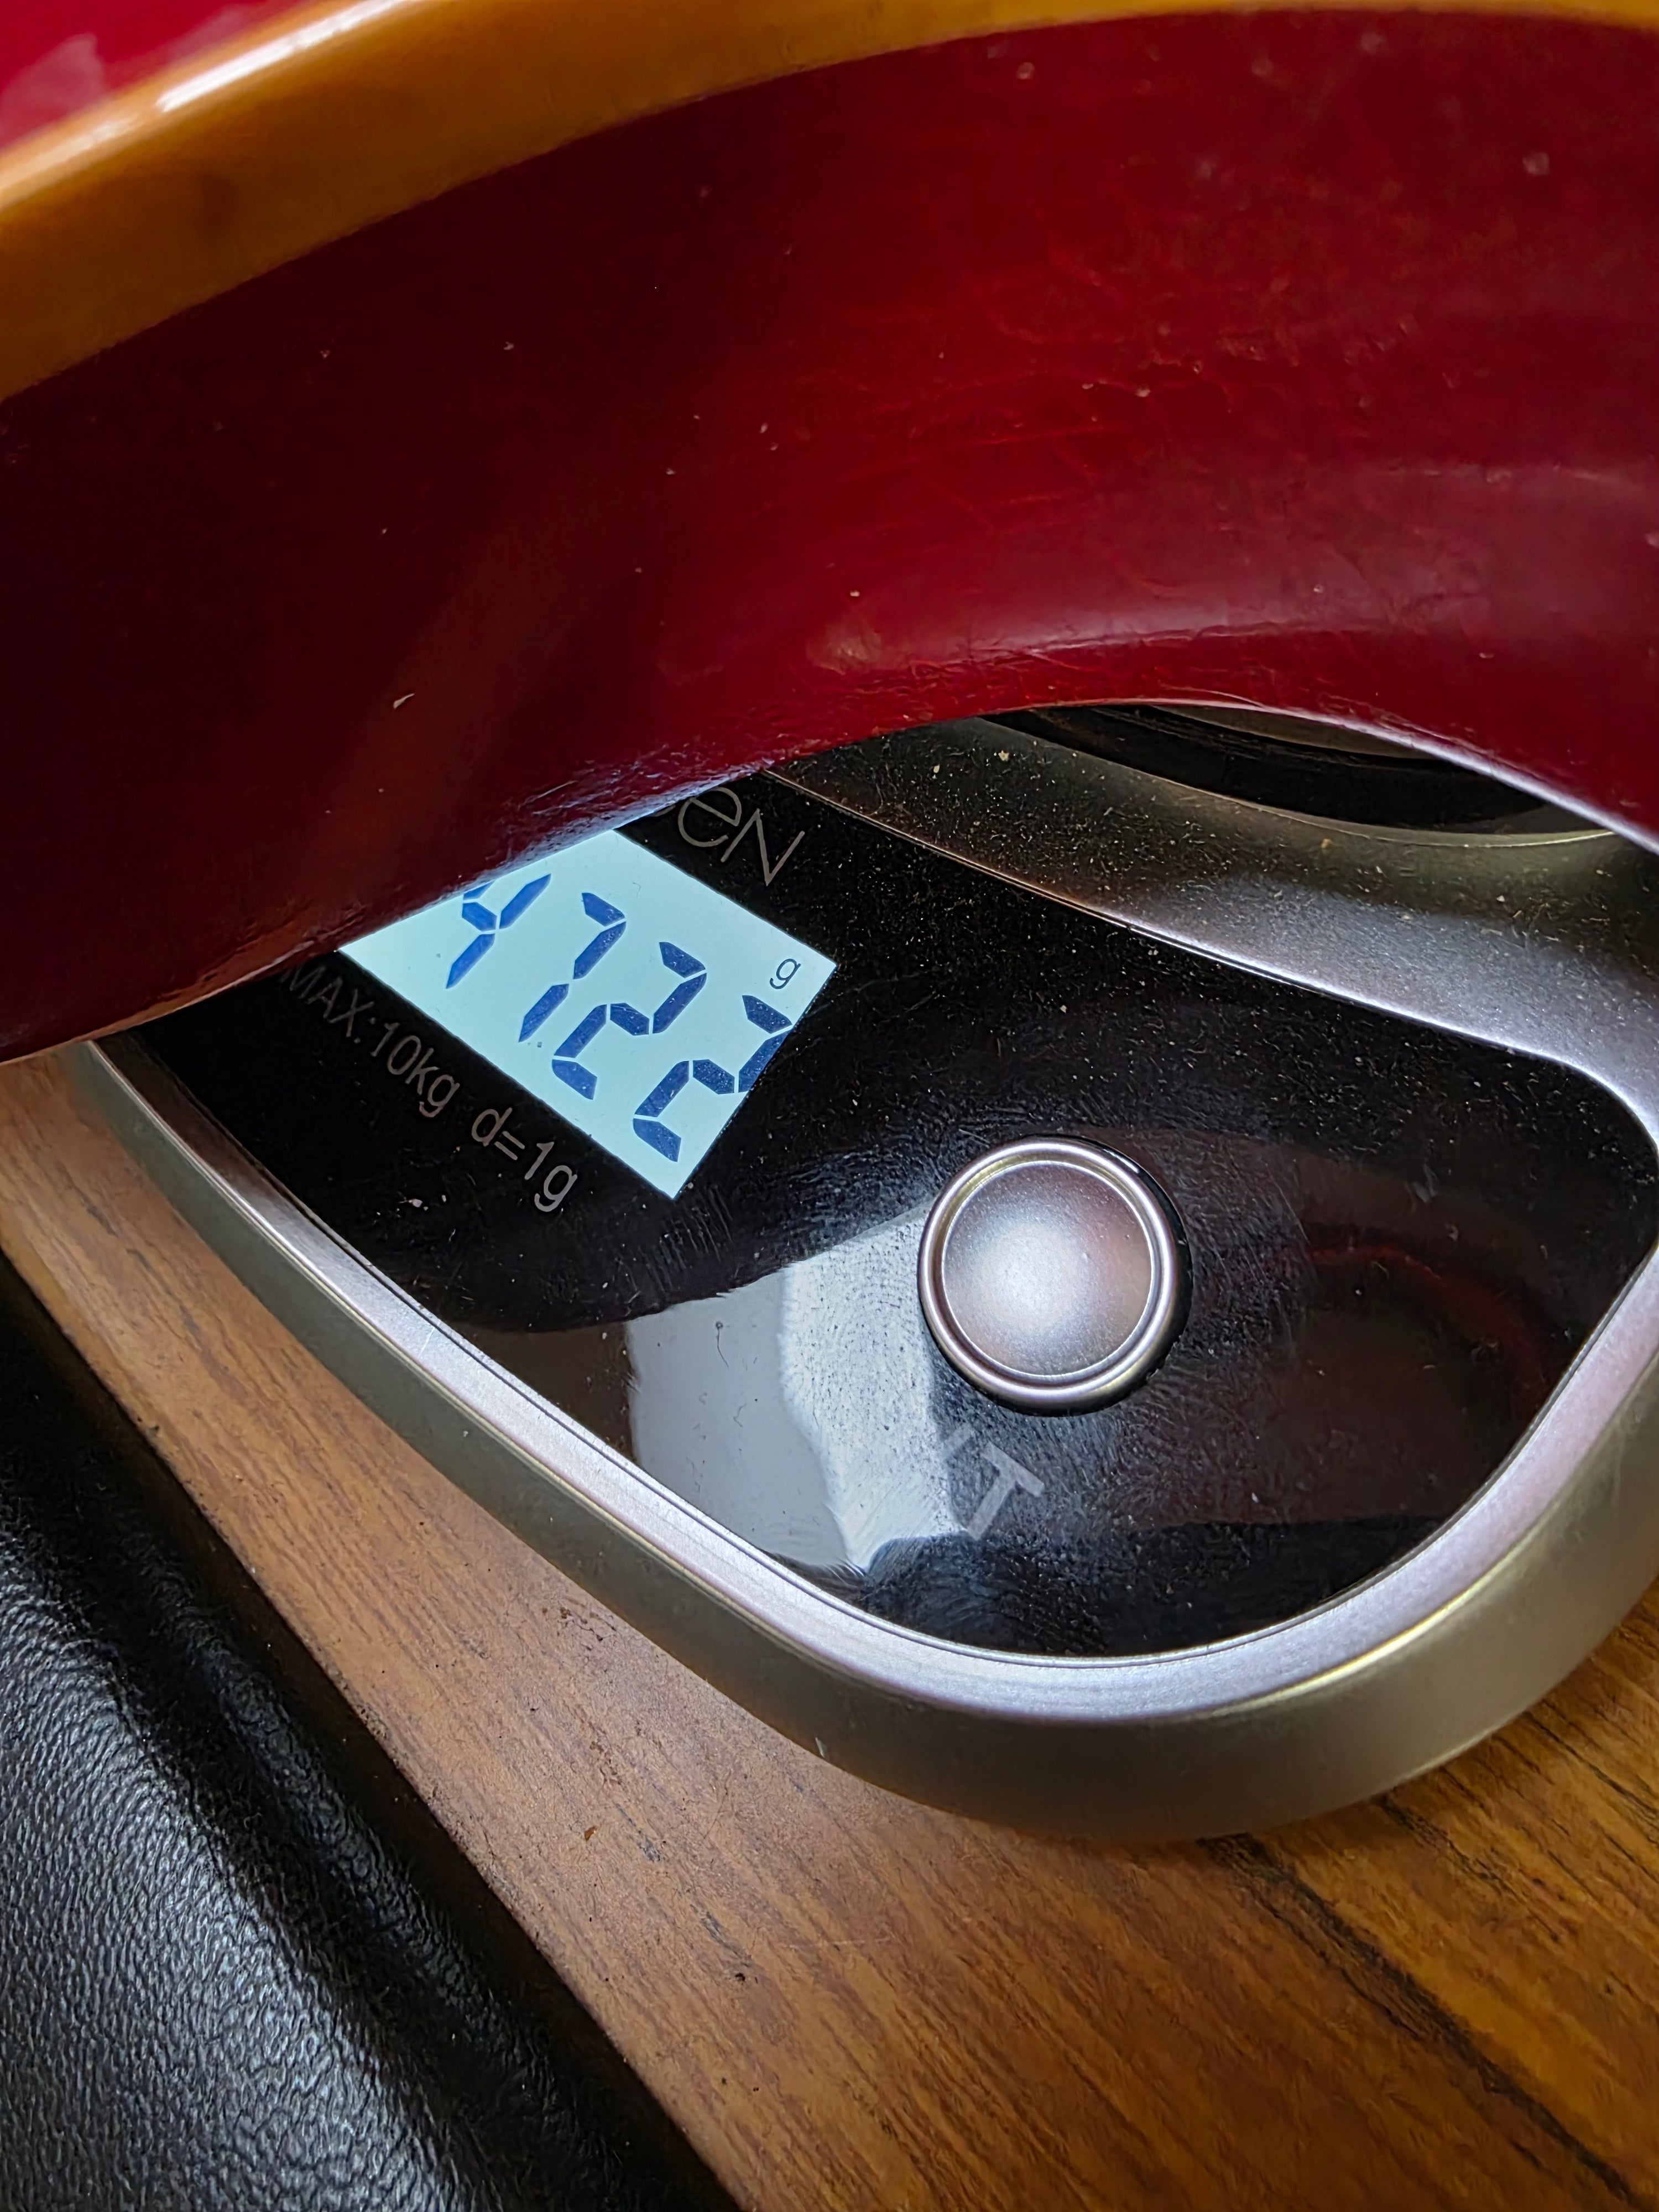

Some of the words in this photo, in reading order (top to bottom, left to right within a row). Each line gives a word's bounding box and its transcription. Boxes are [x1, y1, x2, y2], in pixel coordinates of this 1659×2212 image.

[647, 786, 806, 886] eN
[769, 958, 801, 990] g
[471, 1107, 578, 1212] d=1g
